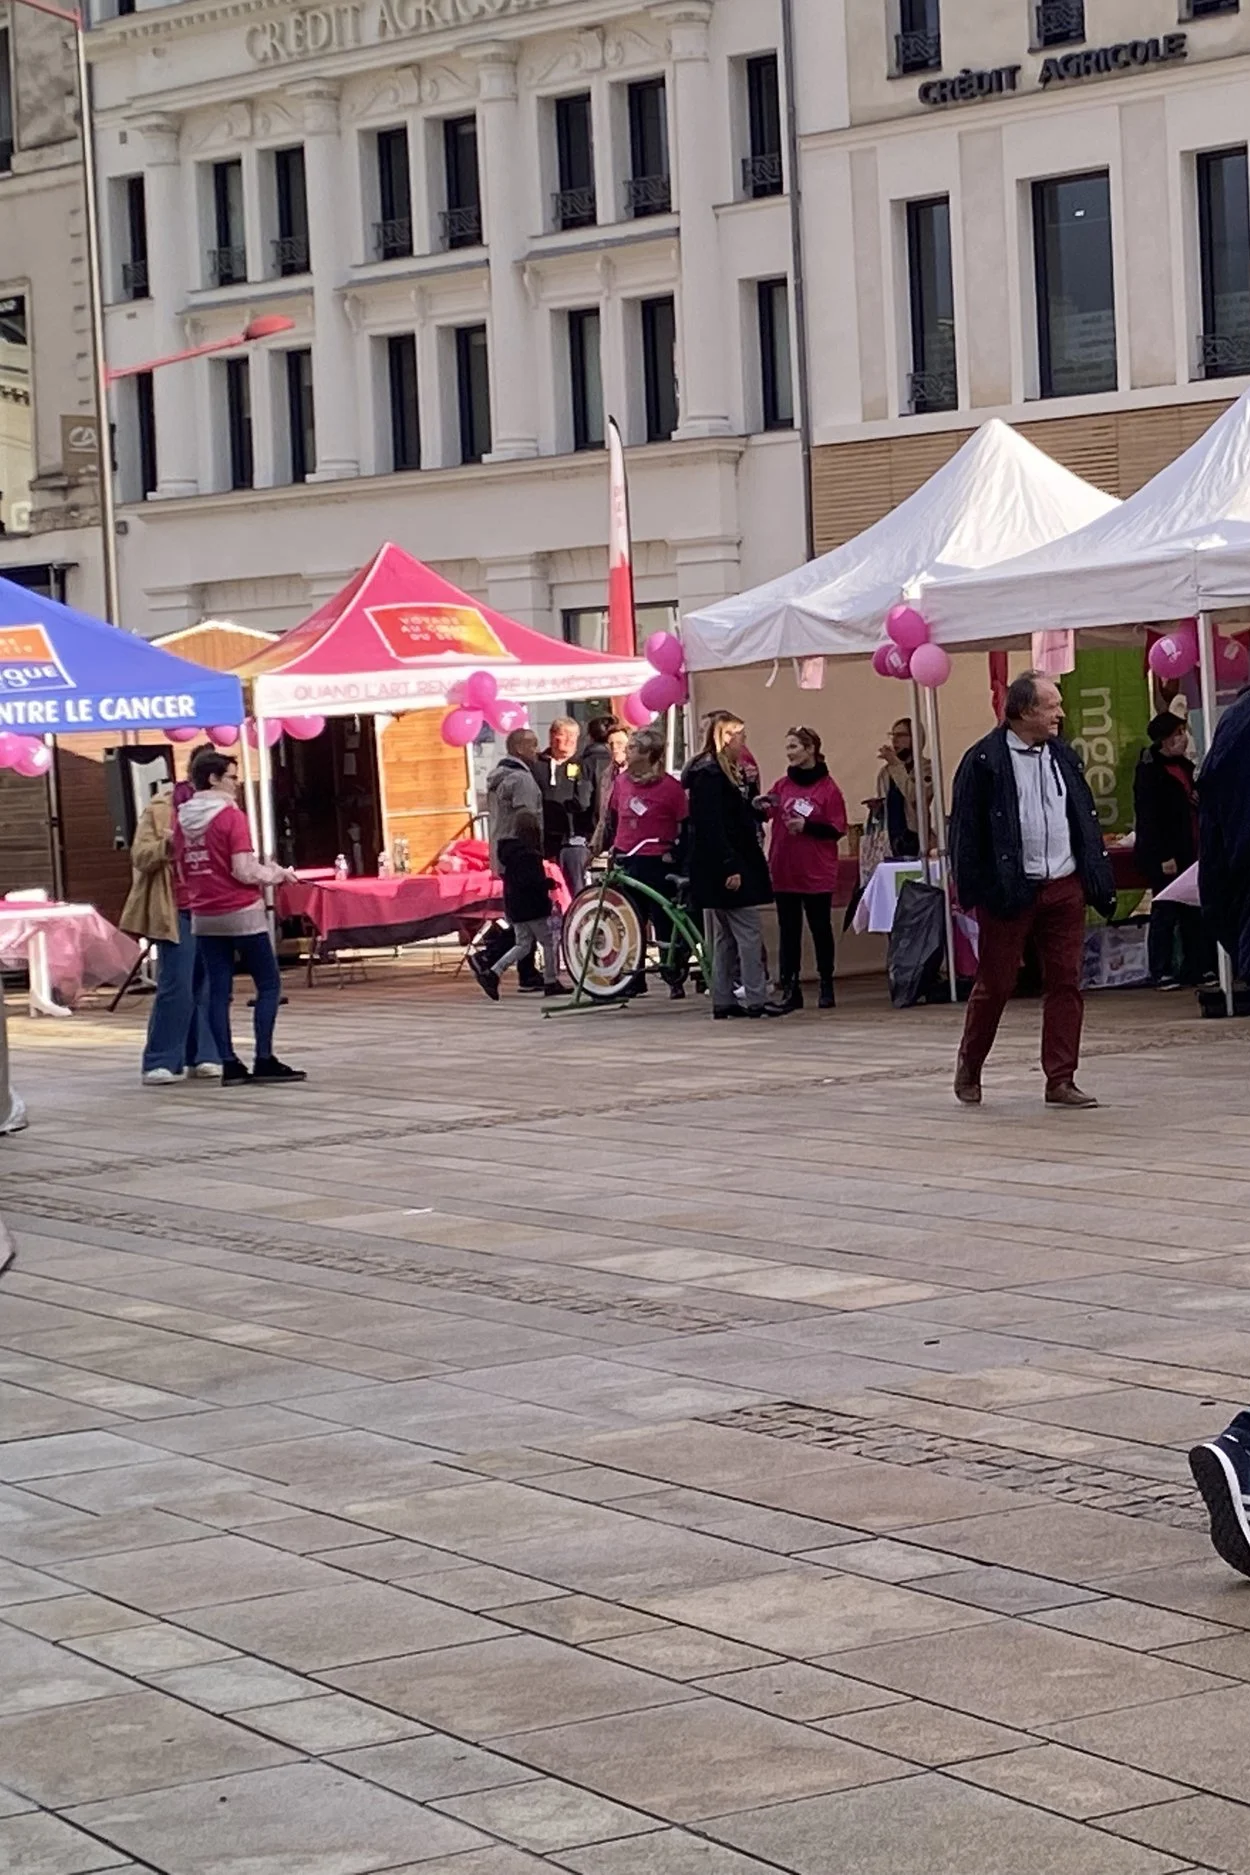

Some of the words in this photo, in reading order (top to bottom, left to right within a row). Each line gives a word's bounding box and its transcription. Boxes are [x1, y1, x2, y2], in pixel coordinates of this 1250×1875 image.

[918, 65, 1021, 104] CRÉDIT
[1038, 33, 1187, 88] AGRICOLE
[0, 698, 60, 725] NTRE
[65, 698, 93, 723] LE
[99, 695, 196, 721] CANCER
[294, 682, 359, 700] QUAND
[1071, 687, 1119, 826] mgen
